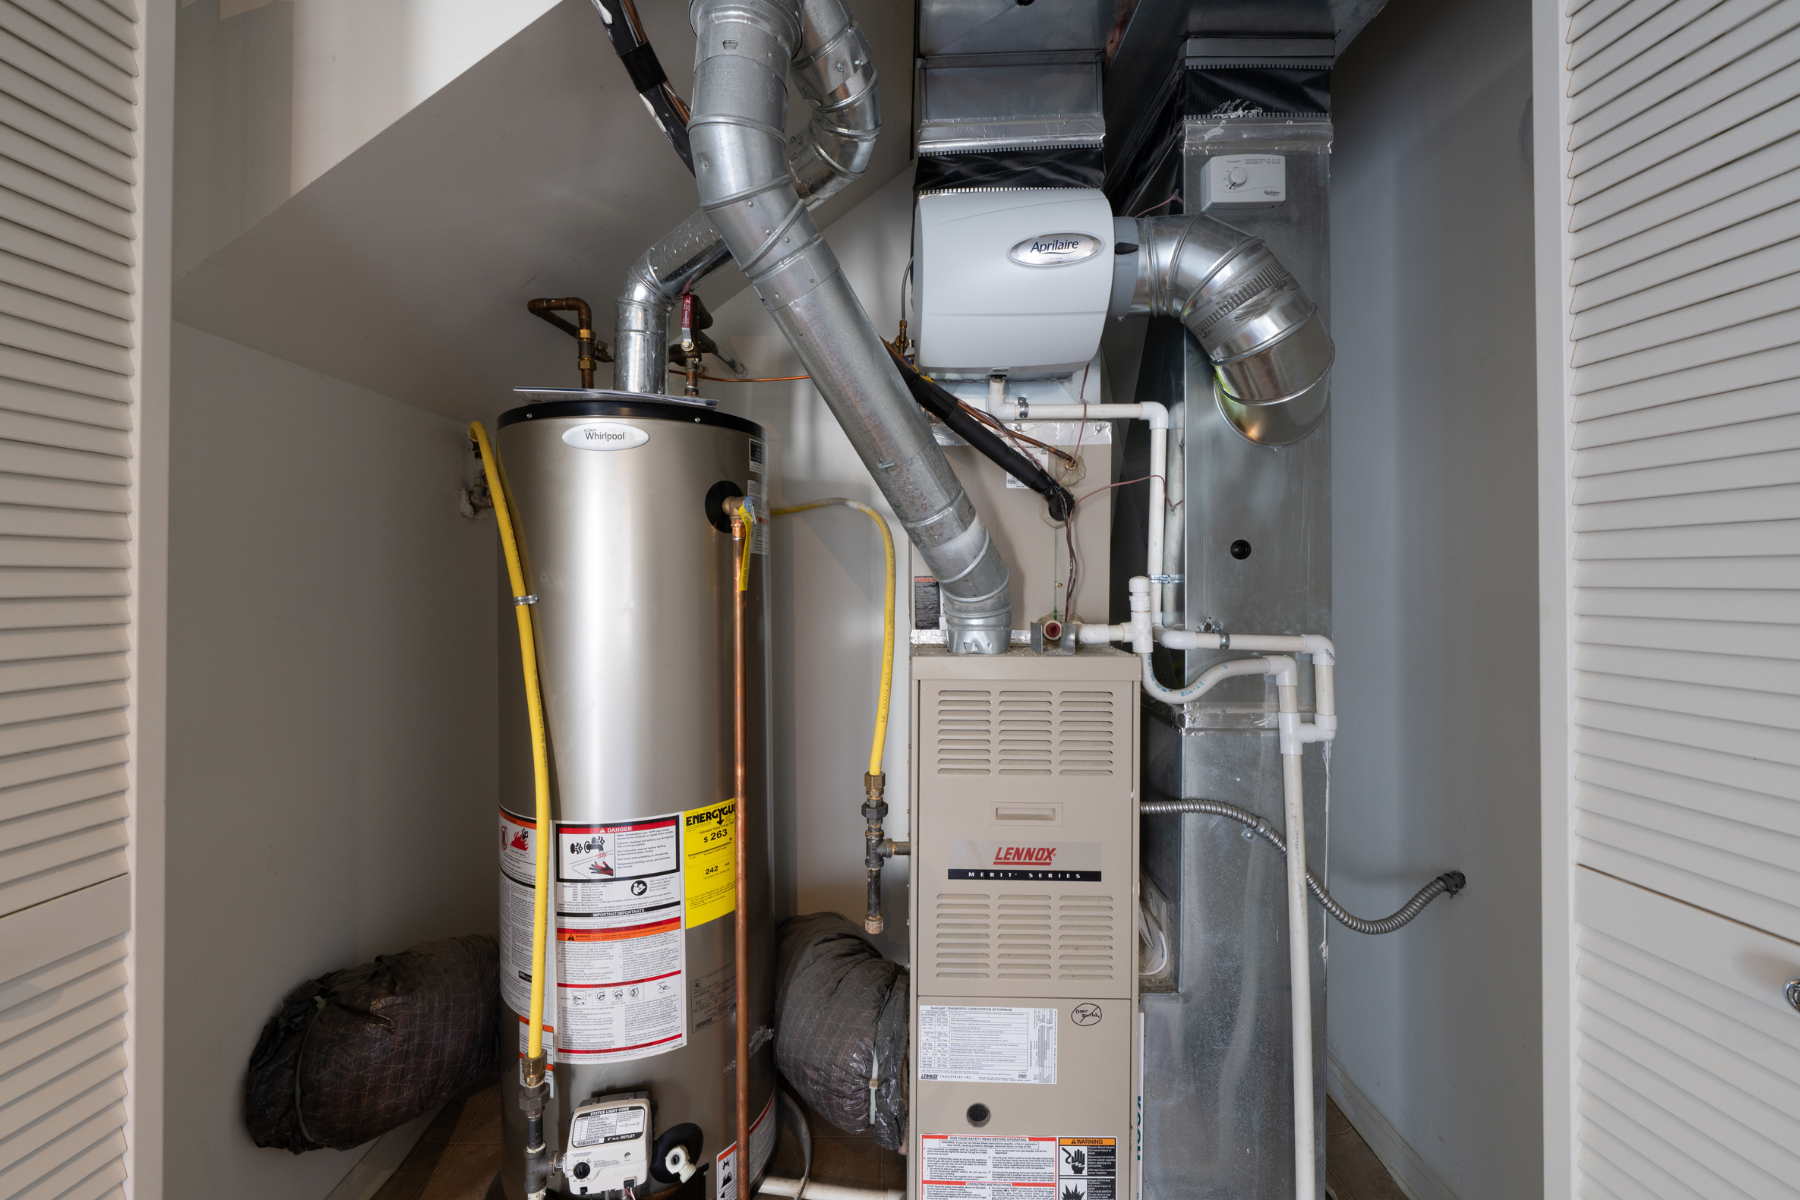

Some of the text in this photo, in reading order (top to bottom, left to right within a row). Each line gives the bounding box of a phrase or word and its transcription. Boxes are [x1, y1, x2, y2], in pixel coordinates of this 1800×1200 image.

[1030, 239, 1079, 253] Aprilaire
[585, 432, 625, 442] Whirlpool
[710, 829, 728, 841] 263
[994, 847, 1057, 861] LENNOX
[705, 865, 719, 875] 242
[642, 921, 663, 929] LIGHTING
[629, 1042, 652, 1050] APPLIANCE
